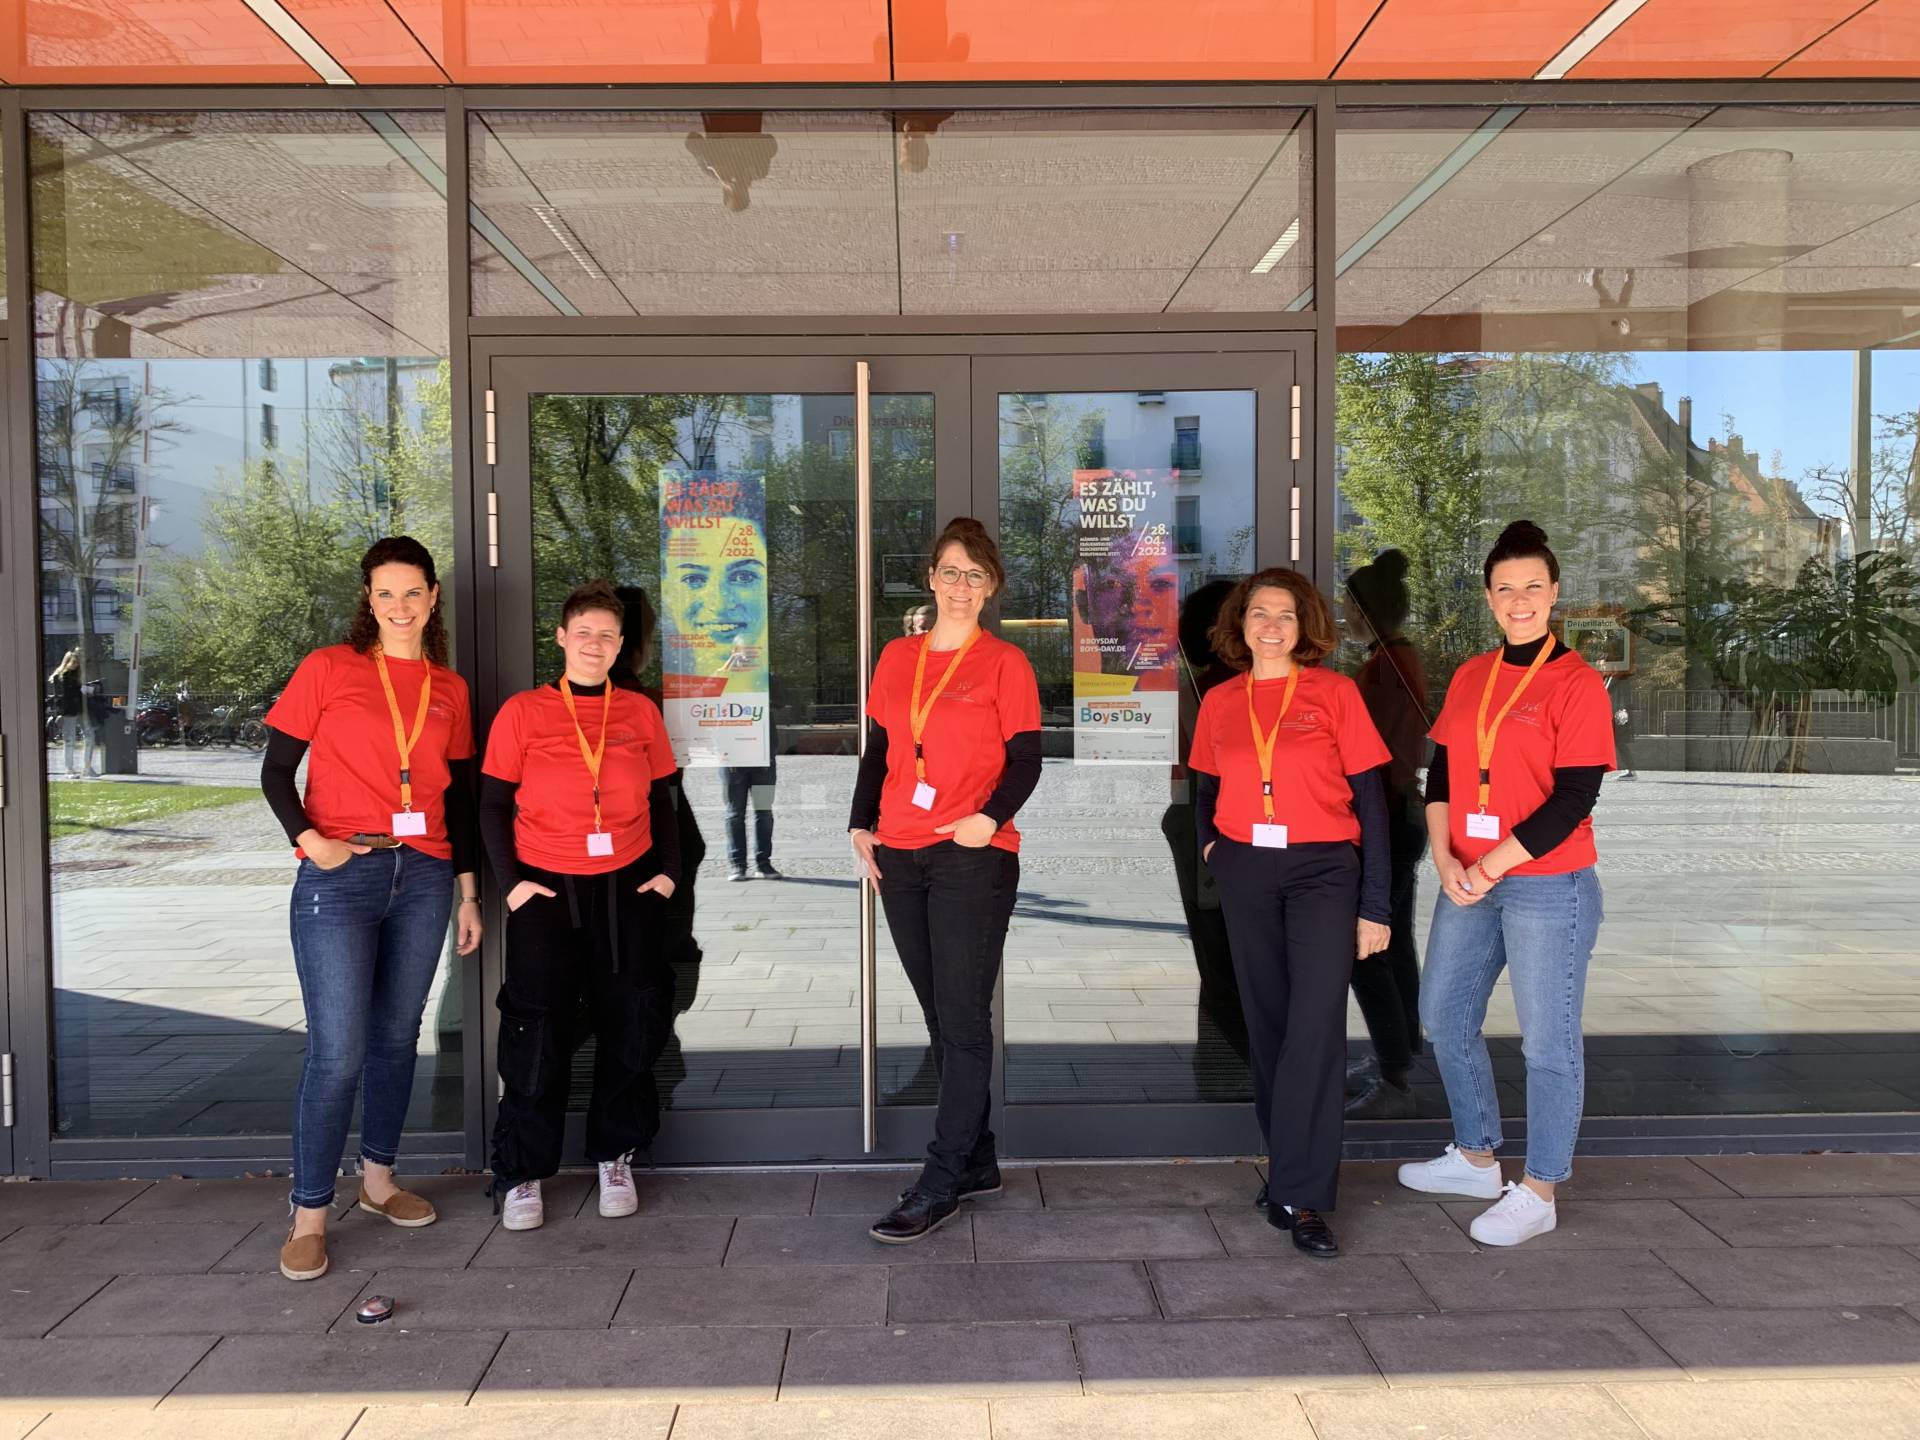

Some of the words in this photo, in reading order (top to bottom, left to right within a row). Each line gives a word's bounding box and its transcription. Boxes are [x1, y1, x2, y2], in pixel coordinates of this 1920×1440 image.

[1080, 481, 1097, 496] ES
[1102, 478, 1156, 498] ZÄHLT,
[666, 498, 704, 513] WAS
[707, 498, 735, 513] DU
[1080, 498, 1117, 513] WAS
[1122, 498, 1146, 512] DU
[665, 515, 721, 529] WILLST
[1080, 514, 1136, 529] WILLST
[1150, 523, 1170, 535] 28.
[1144, 535, 1165, 547] 04.
[726, 548, 755, 557] 2022
[1137, 547, 1167, 556] 2022
[1080, 645, 1126, 653] BOYS-DAY.DE
[1081, 707, 1151, 725] Boys'Day
